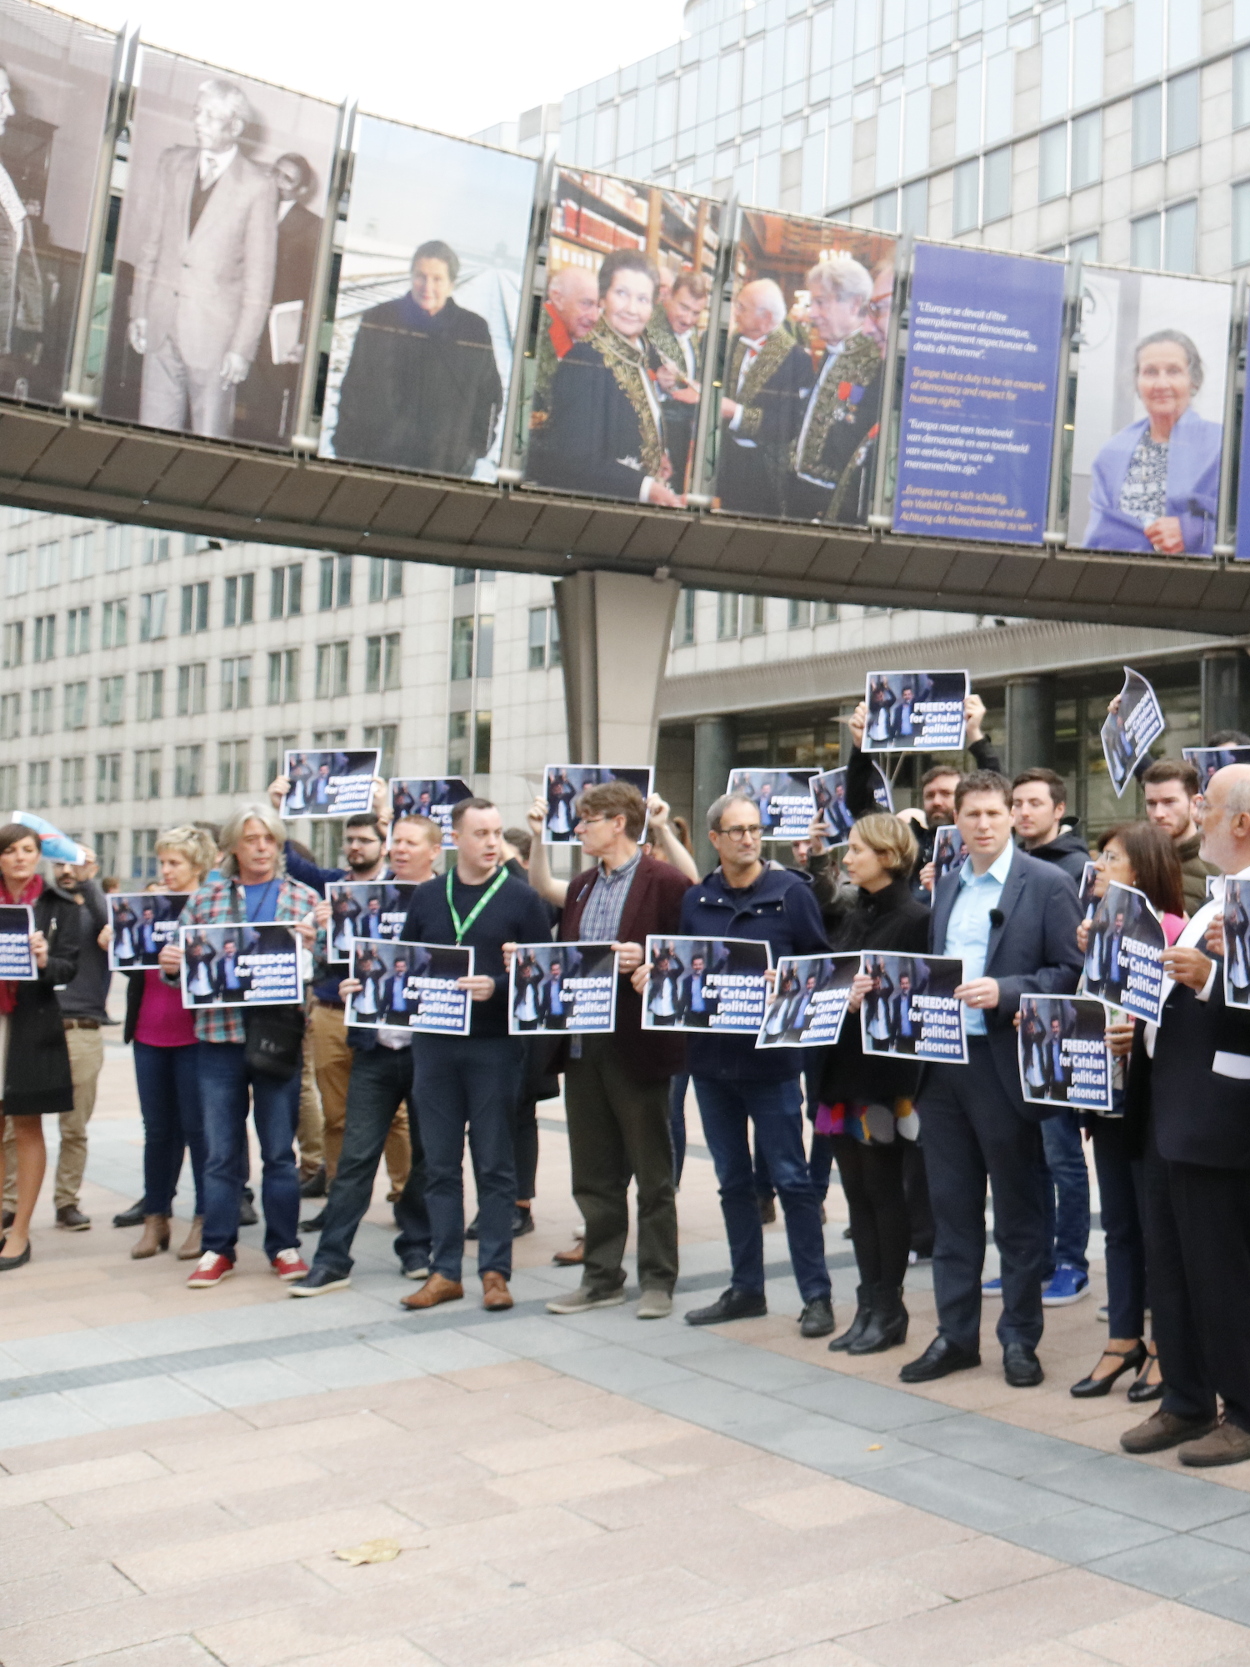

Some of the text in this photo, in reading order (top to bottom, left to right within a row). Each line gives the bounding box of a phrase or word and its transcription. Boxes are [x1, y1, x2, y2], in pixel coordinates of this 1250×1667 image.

[914, 701, 962, 712] FREEDOM
[910, 713, 961, 723] for Catalan
[922, 723, 960, 735] political
[914, 734, 958, 746] prisoners
[767, 805, 780, 815] for
[152, 932, 165, 941] for
[238, 953, 295, 965] FREEDOM
[1117, 951, 1162, 980] for Catalan
[234, 965, 295, 977] for Catalan
[251, 975, 295, 988] political
[408, 976, 459, 990] FREEDO
[563, 976, 611, 989] FREEDOM
[706, 974, 764, 987] FREEDOM
[1127, 975, 1159, 997] political
[244, 987, 296, 1000] prisoners
[403, 989, 465, 1002] for Catalan
[559, 989, 610, 1002] for Catalan
[701, 986, 764, 1000] for Catalan
[811, 988, 849, 1003] FREEDOM
[418, 1003, 464, 1015] political
[573, 1001, 610, 1015] political
[717, 1000, 763, 1013] political
[804, 1001, 844, 1016] for Catalan
[912, 995, 959, 1011] FREEDOM
[1121, 990, 1158, 1014] prisoners
[409, 1013, 463, 1027] prisoners
[566, 1015, 608, 1028] prisoners
[709, 1014, 761, 1027] prisoners
[809, 1012, 841, 1028] political
[908, 1008, 959, 1025] for Catalan
[800, 1026, 836, 1041] prisoners
[921, 1025, 959, 1040] political
[915, 1038, 961, 1054] prisoners
[1062, 1039, 1104, 1054] FREEDOM
[1059, 1053, 1105, 1070] for Catalan
[1071, 1070, 1105, 1085] political
[1067, 1083, 1106, 1100] prisoners
